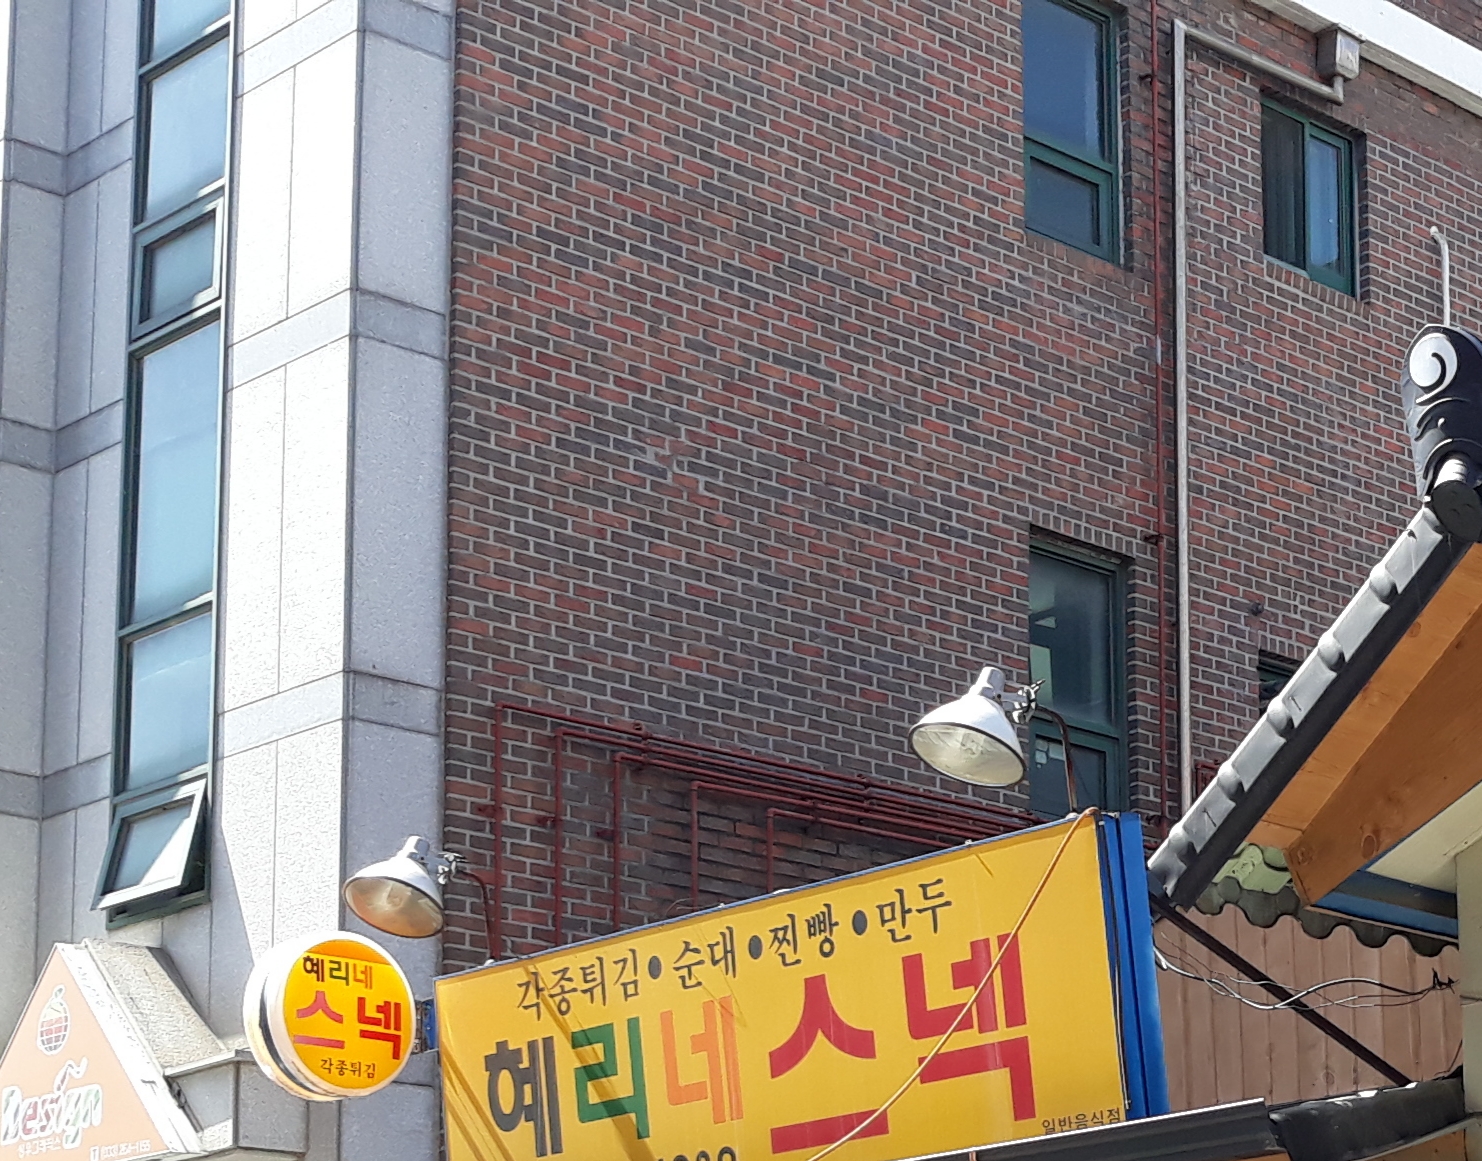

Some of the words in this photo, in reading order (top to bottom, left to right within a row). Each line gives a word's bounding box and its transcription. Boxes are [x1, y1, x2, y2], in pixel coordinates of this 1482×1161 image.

[302, 955, 373, 989] 혜리네
[517, 948, 640, 1021] 각종튀김
[673, 926, 736, 990] 순대
[767, 903, 837, 969] 찐빵
[876, 878, 954, 944] 만두
[293, 990, 402, 1061] 스넥
[484, 995, 744, 1158] 혜리네
[769, 931, 1036, 1155] 스넥
[320, 1058, 376, 1079] 각종튀김
[1042, 1107, 1120, 1135] 일반음식점
